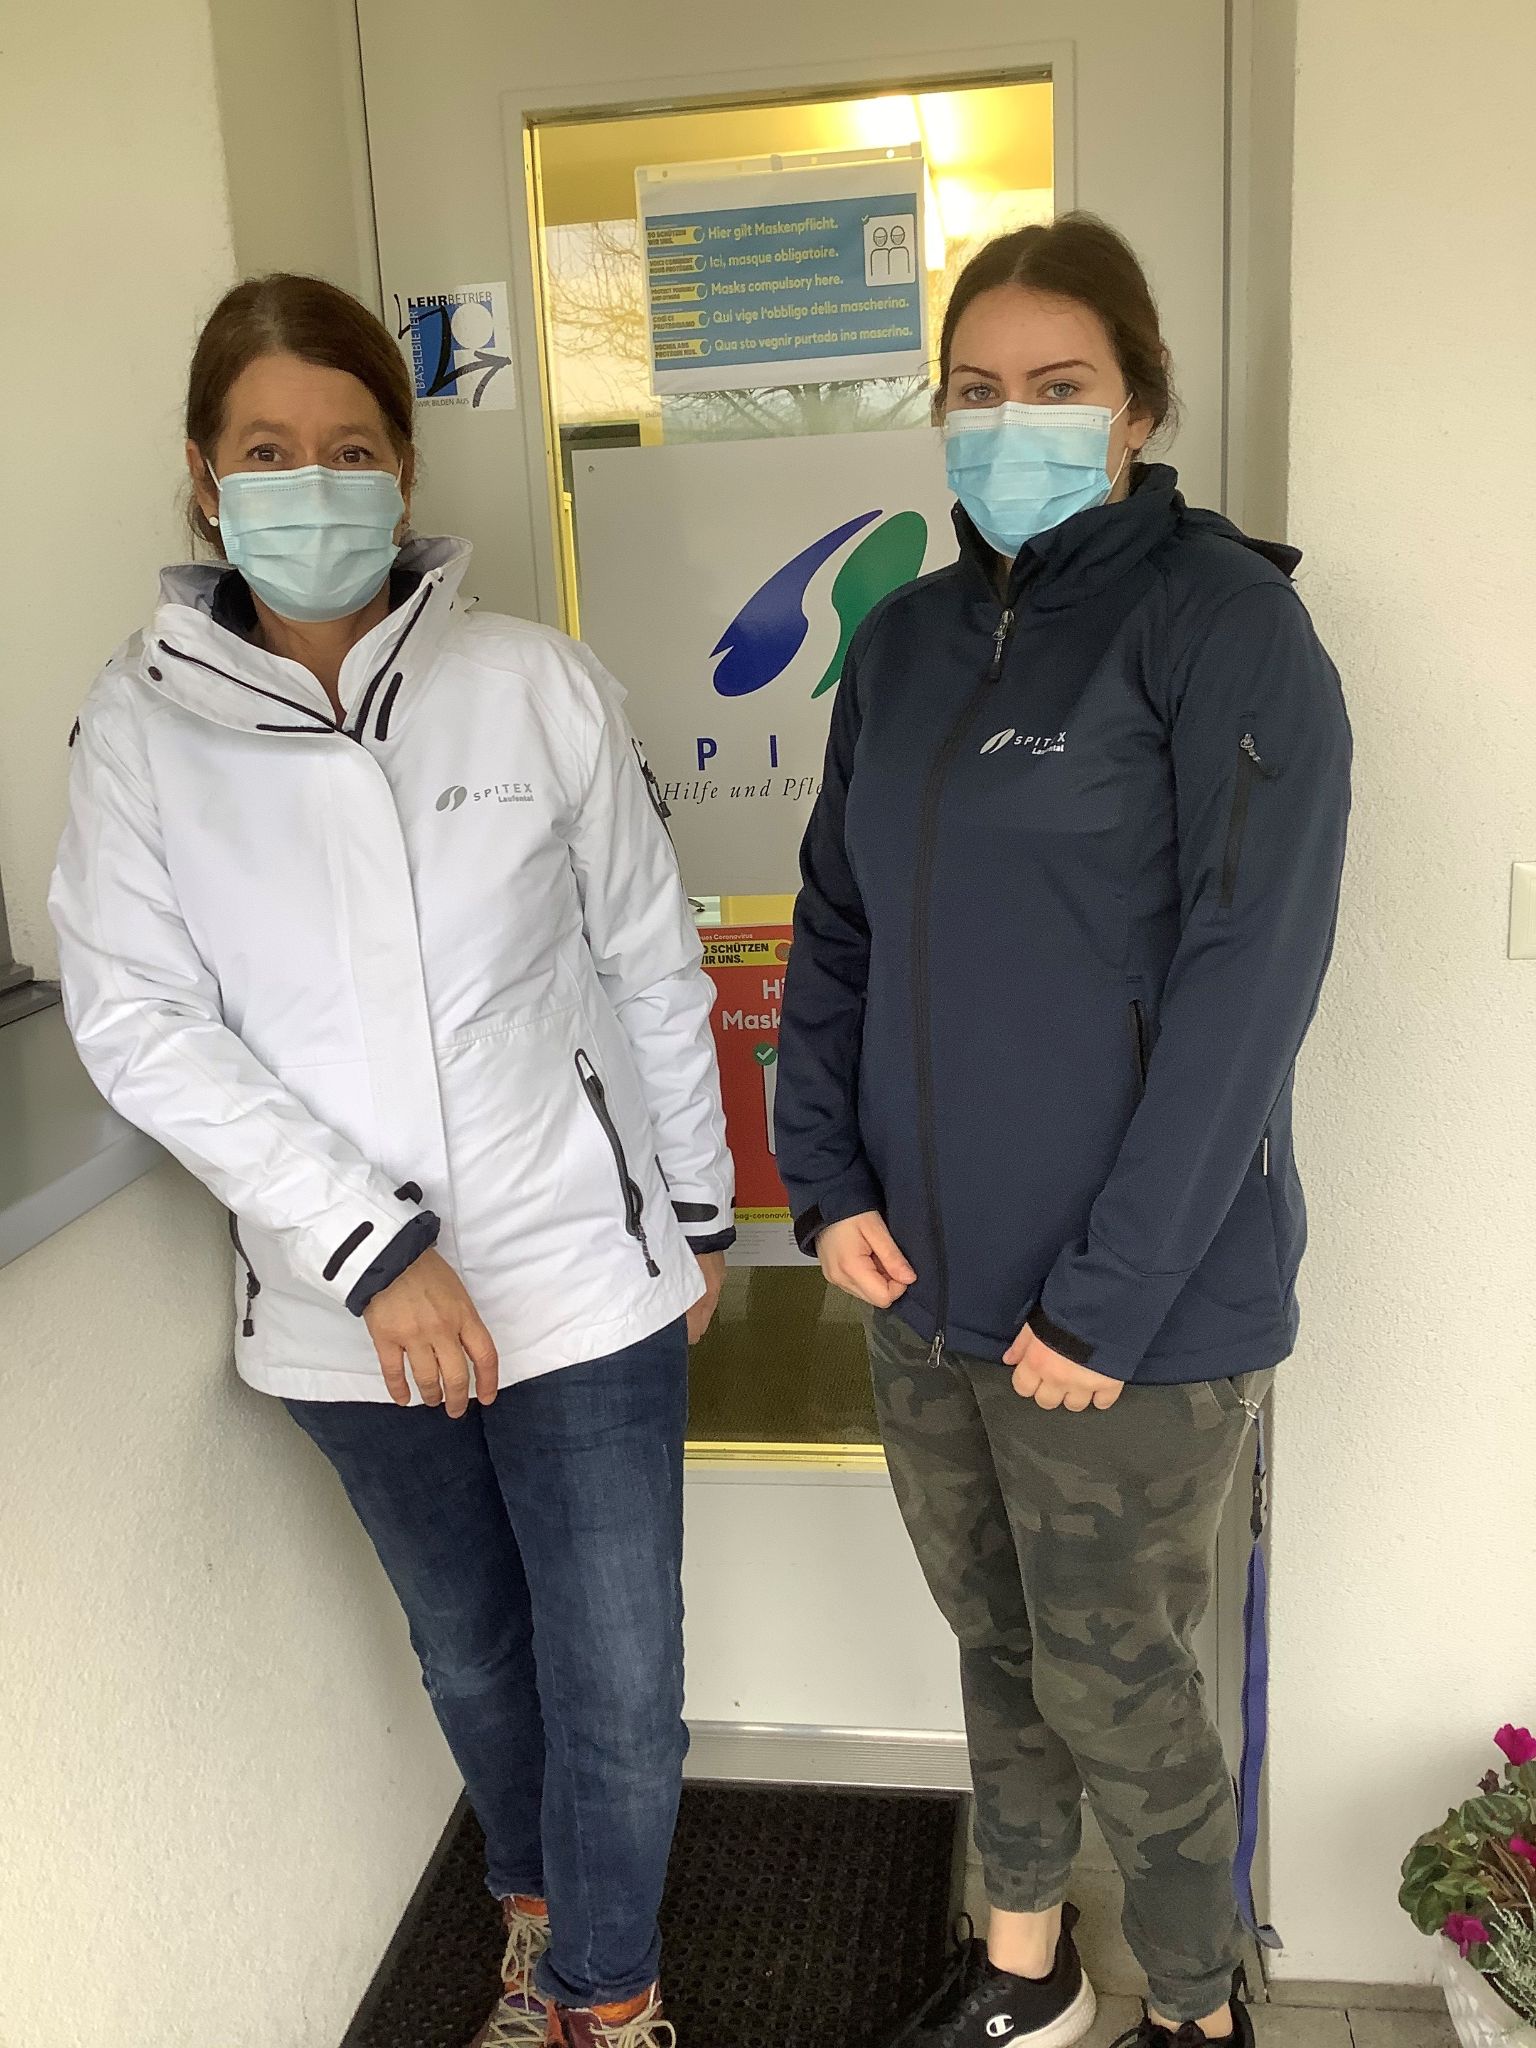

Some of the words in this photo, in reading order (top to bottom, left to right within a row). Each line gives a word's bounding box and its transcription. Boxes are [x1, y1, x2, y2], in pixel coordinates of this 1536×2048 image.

[708, 226, 731, 240] Hier
[733, 223, 752, 241] gilt
[754, 216, 839, 236] Maskenpflicht.
[709, 253, 727, 269] Ici,
[728, 252, 772, 267] masque
[774, 245, 839, 264] obligatoire.
[711, 280, 746, 296] Masks
[748, 276, 813, 294] compulsory
[814, 273, 843, 286] here.
[407, 291, 493, 309] LEHRBETRIEB
[712, 310, 733, 324] Qui
[735, 309, 758, 325] vige
[810, 300, 838, 314] della
[840, 296, 910, 313] mascherina.
[714, 339, 738, 351] Qua
[740, 336, 757, 349] sto
[758, 333, 792, 350] vegnir
[794, 330, 838, 347] purtada
[859, 323, 913, 339] mascrina.
[410, 311, 426, 389] BASELBIETER
[1013, 731, 1067, 748] SPITX
[473, 783, 533, 802] SPITEX
[662, 780, 718, 805] Hilfe
[729, 779, 771, 798] und
[782, 777, 822, 801] Pfle
[713, 931, 754, 940] Coronavirus
[710, 941, 769, 954] SCHÜTZEN
[717, 954, 744, 964] UNS.
[721, 1008, 781, 1030] Mask
